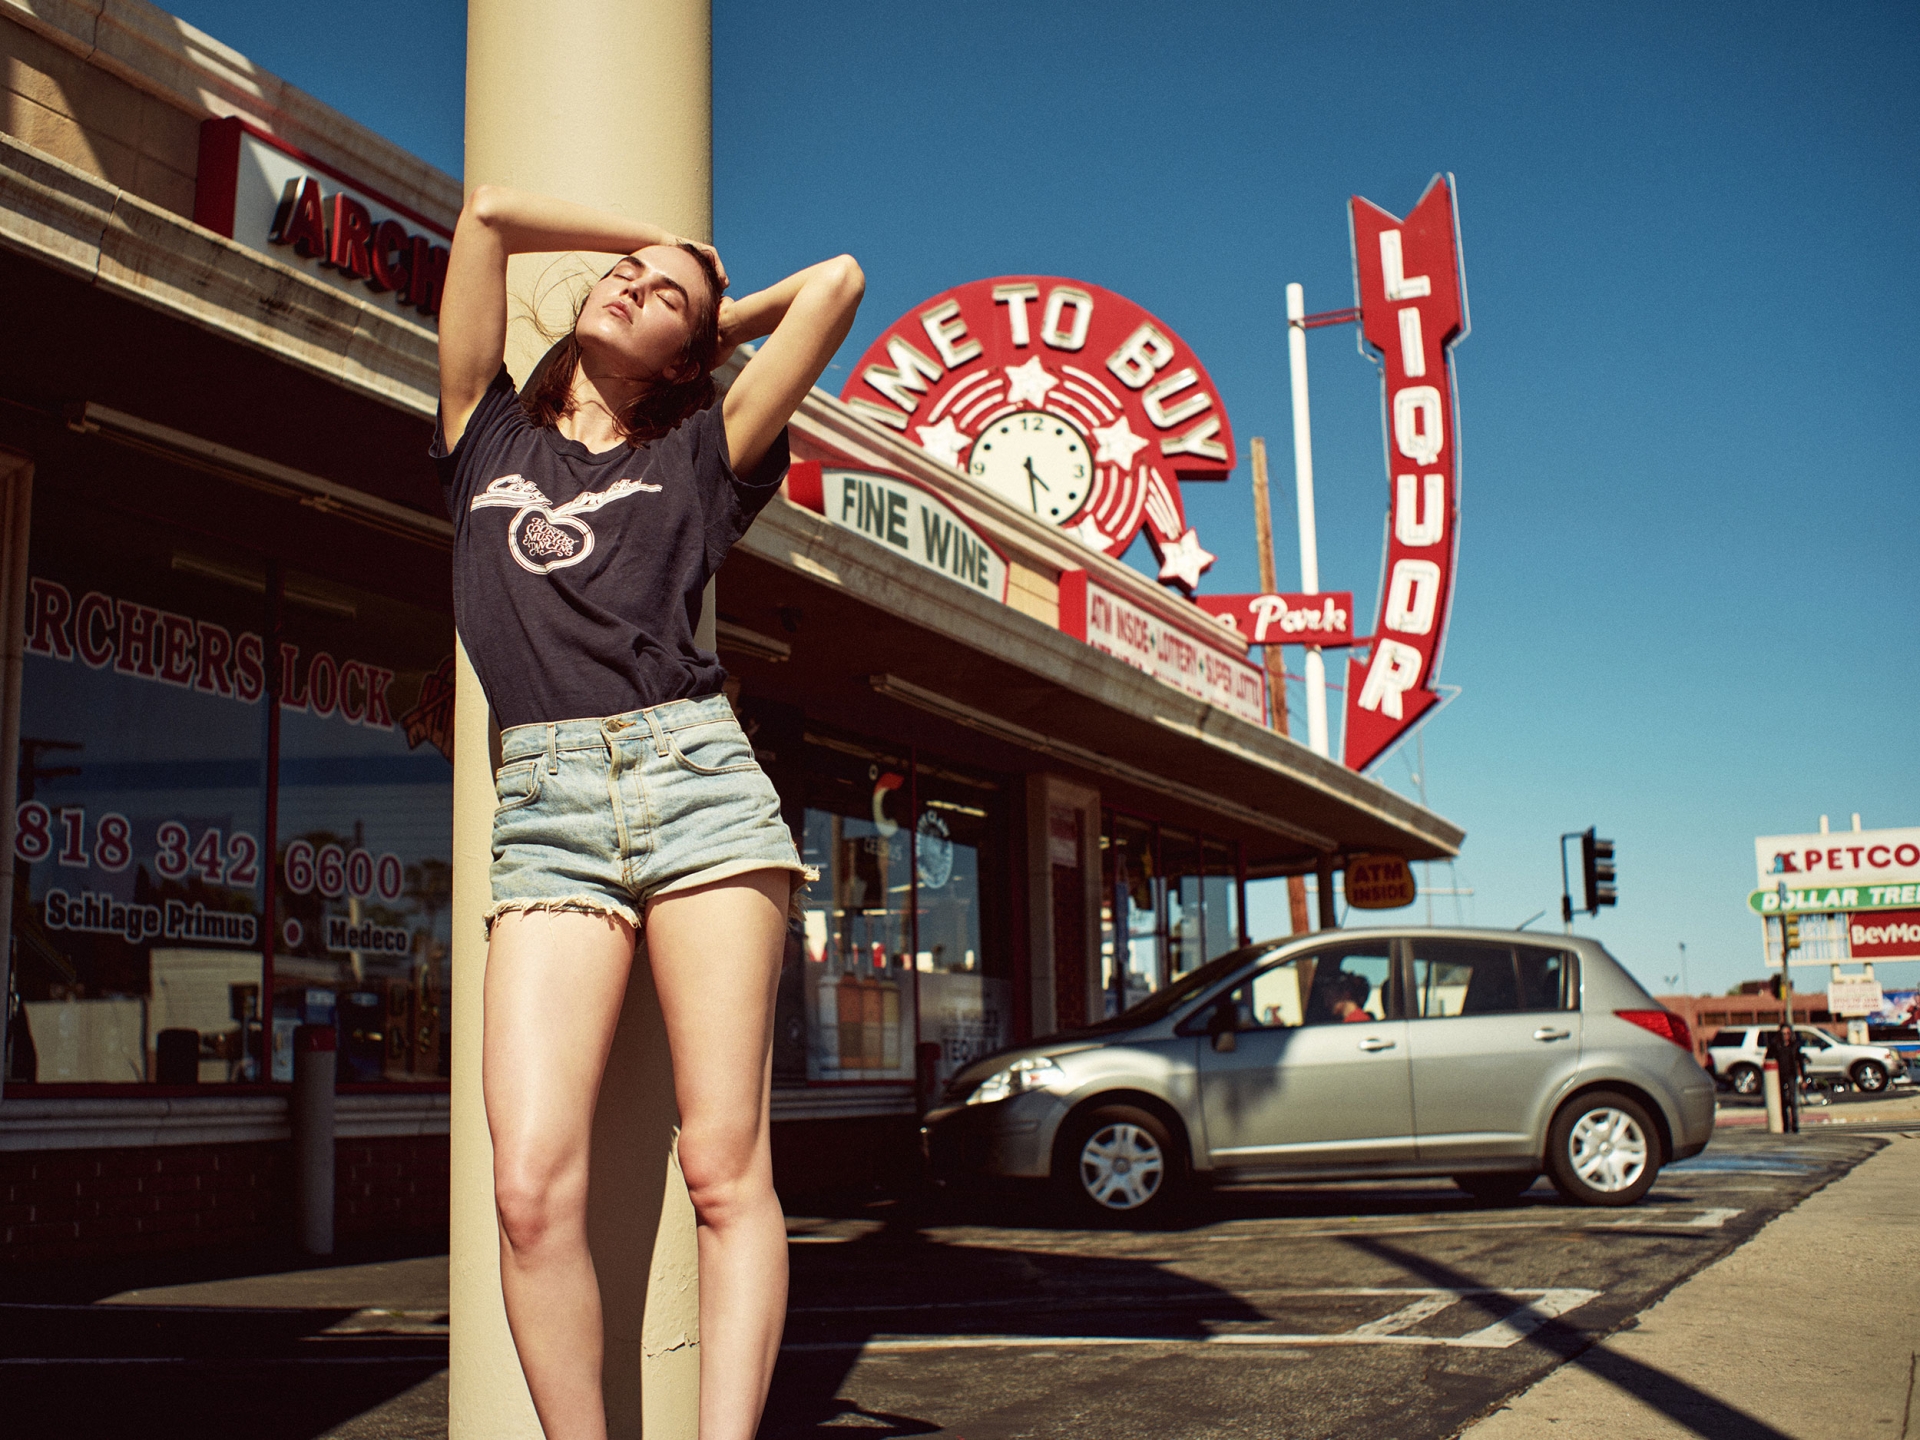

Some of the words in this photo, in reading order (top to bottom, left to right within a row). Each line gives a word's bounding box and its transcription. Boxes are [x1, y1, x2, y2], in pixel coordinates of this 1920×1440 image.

[269, 174, 451, 316] ARCH
[847, 298, 984, 431] IME
[992, 282, 1094, 352] TO
[1105, 320, 1229, 461] BUY
[1020, 417, 1046, 432] 12
[1073, 464, 1085, 479] 3
[1357, 228, 1445, 720] LIQUOR
[841, 477, 909, 551] FINE
[920, 505, 990, 590] WINE
[1248, 595, 1348, 642] Park
[24, 576, 266, 703] RCHERS
[278, 641, 395, 732] LOCK
[14, 800, 132, 873] 818
[155, 820, 260, 888] 342
[284, 840, 402, 900] 6600
[1354, 862, 1403, 883] ATM
[1804, 843, 1920, 872] PETCO
[1353, 883, 1407, 901] INSIDE
[1869, 884, 1920, 906] TRE
[45, 888, 162, 943] Schlage
[163, 900, 258, 946] Primus
[326, 917, 409, 954] Medeco
